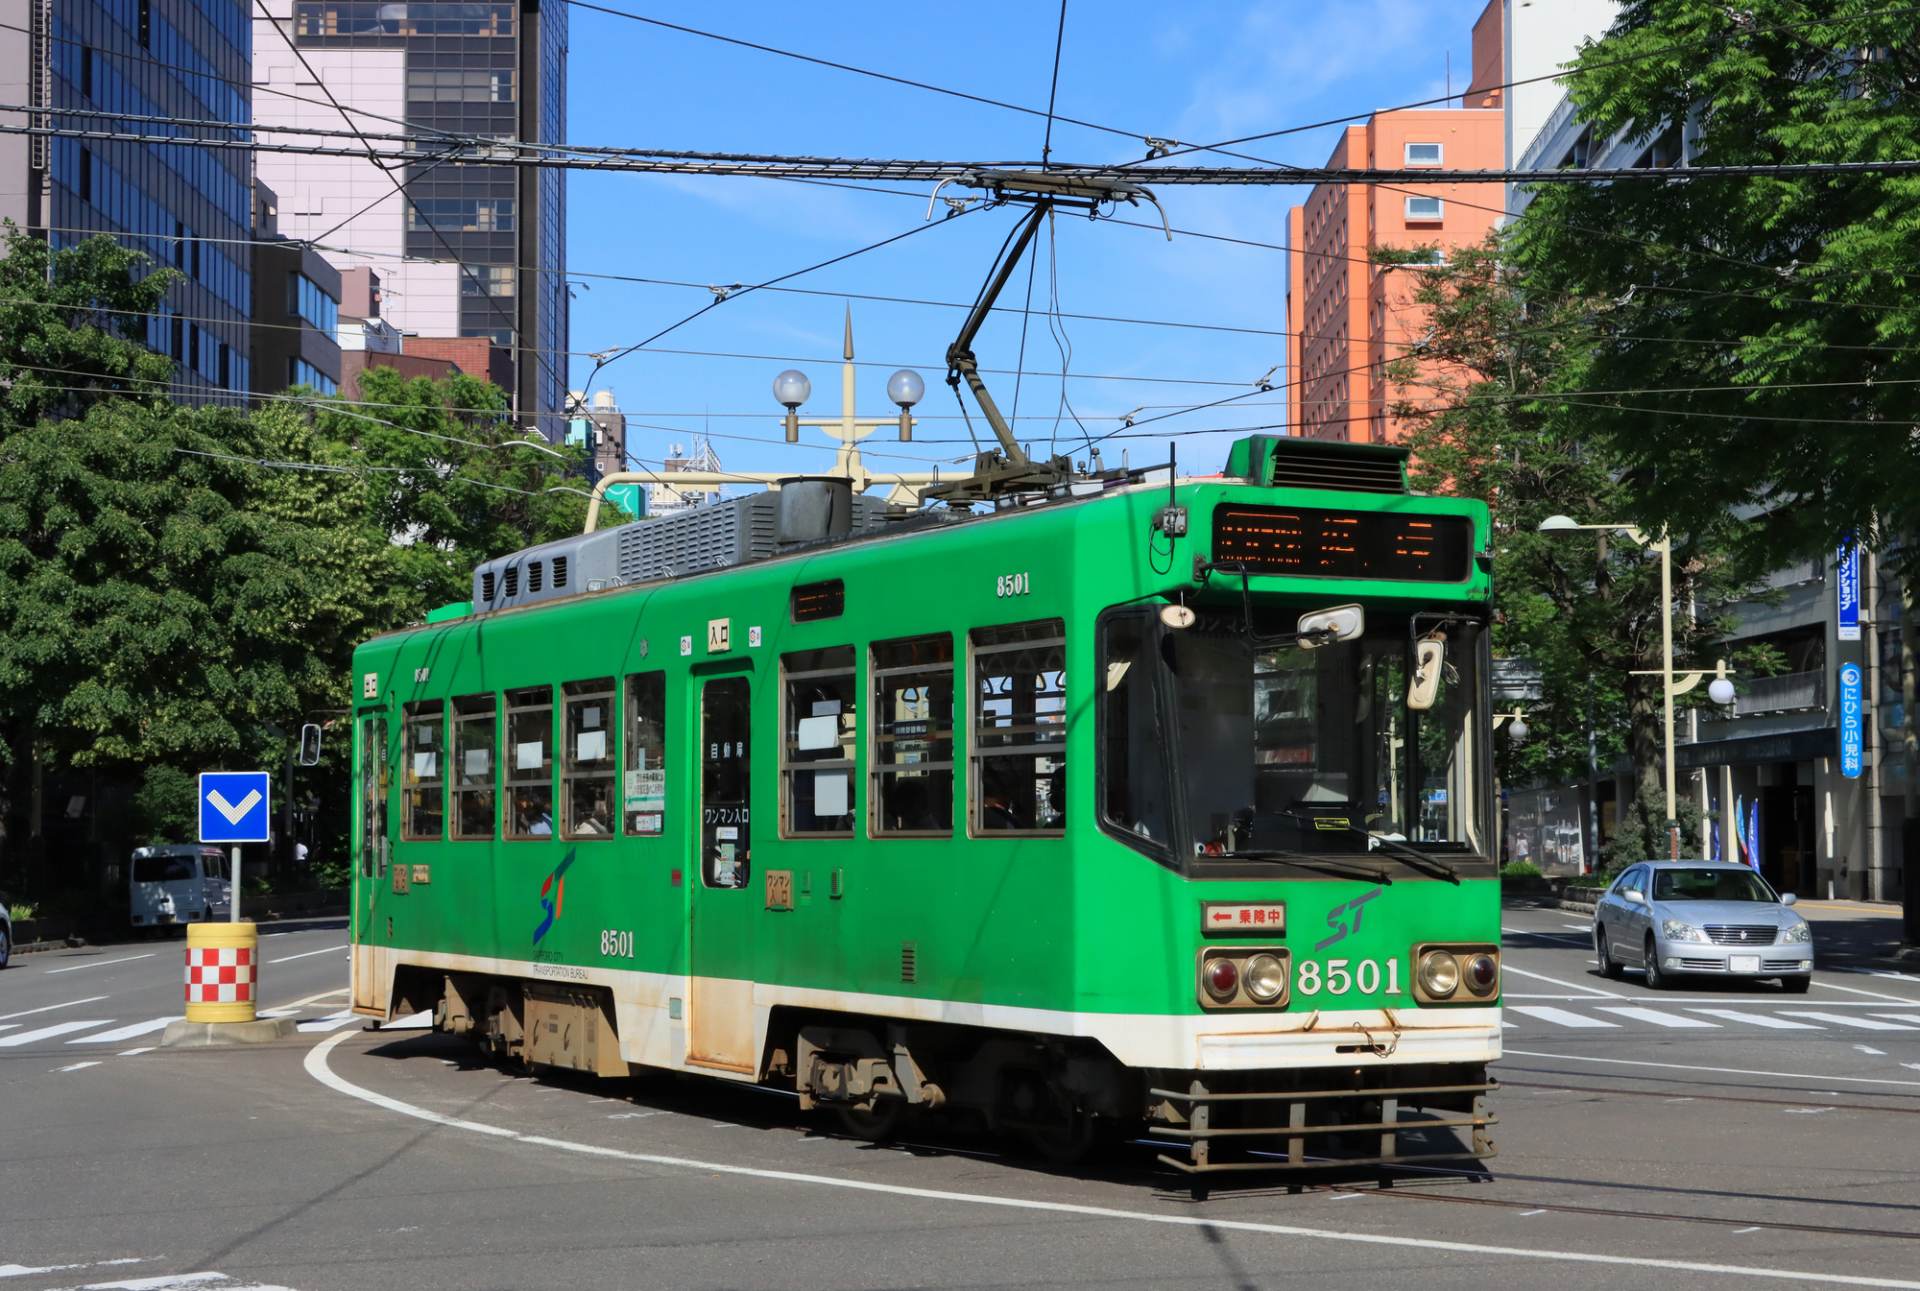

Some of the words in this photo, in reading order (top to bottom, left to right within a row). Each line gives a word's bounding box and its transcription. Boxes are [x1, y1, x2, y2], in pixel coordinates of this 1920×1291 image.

[997, 571, 1030, 598] 8501
[711, 625, 728, 645] 入口
[1844, 688, 1859, 771] にひら小児科
[705, 808, 749, 824] ワンマン入口
[768, 875, 790, 887] ワンマン
[770, 890, 788, 903] 入口
[1239, 909, 1280, 925] 乗降中
[601, 929, 634, 958] 8501
[1298, 958, 1402, 996] 8501
